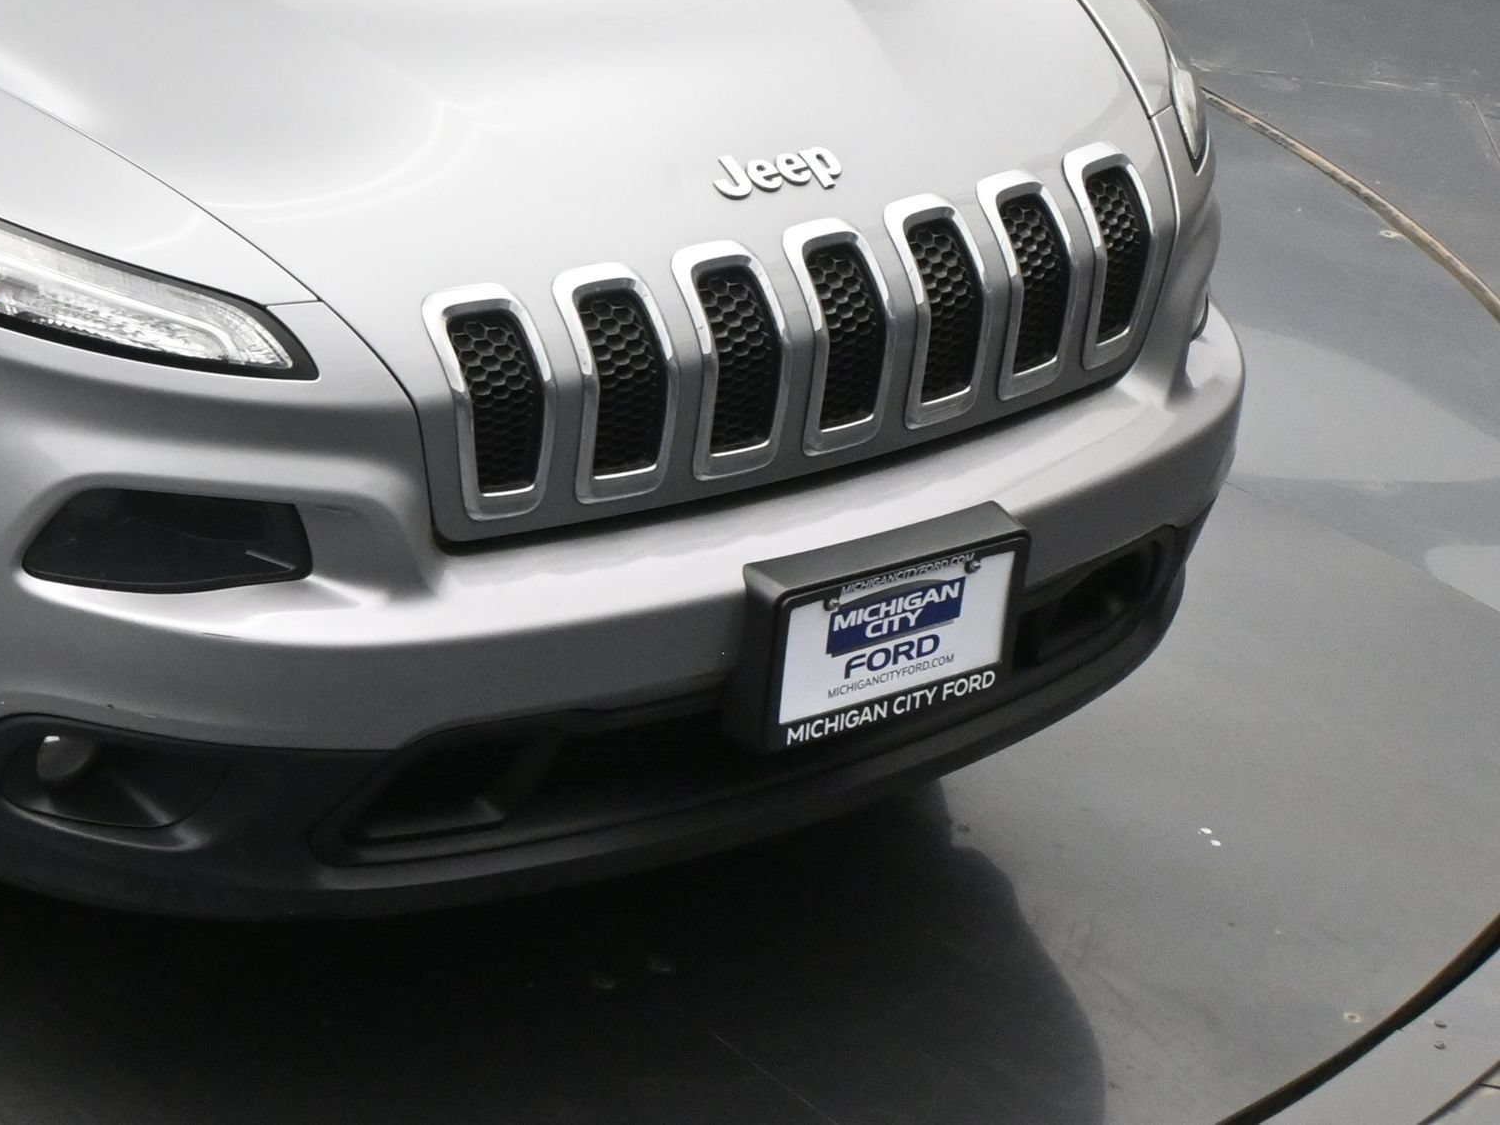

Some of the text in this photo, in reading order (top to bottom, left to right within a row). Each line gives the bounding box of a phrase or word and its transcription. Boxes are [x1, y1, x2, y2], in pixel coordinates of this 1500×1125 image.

[712, 146, 843, 201] Jeep
[832, 581, 961, 632] MICHIGAN
[864, 608, 925, 639] CITY
[827, 653, 955, 699] MICHIGANCITYFORD.COM
[843, 633, 941, 680] FORD
[785, 669, 997, 747] MICHIGAN CITY FORD
